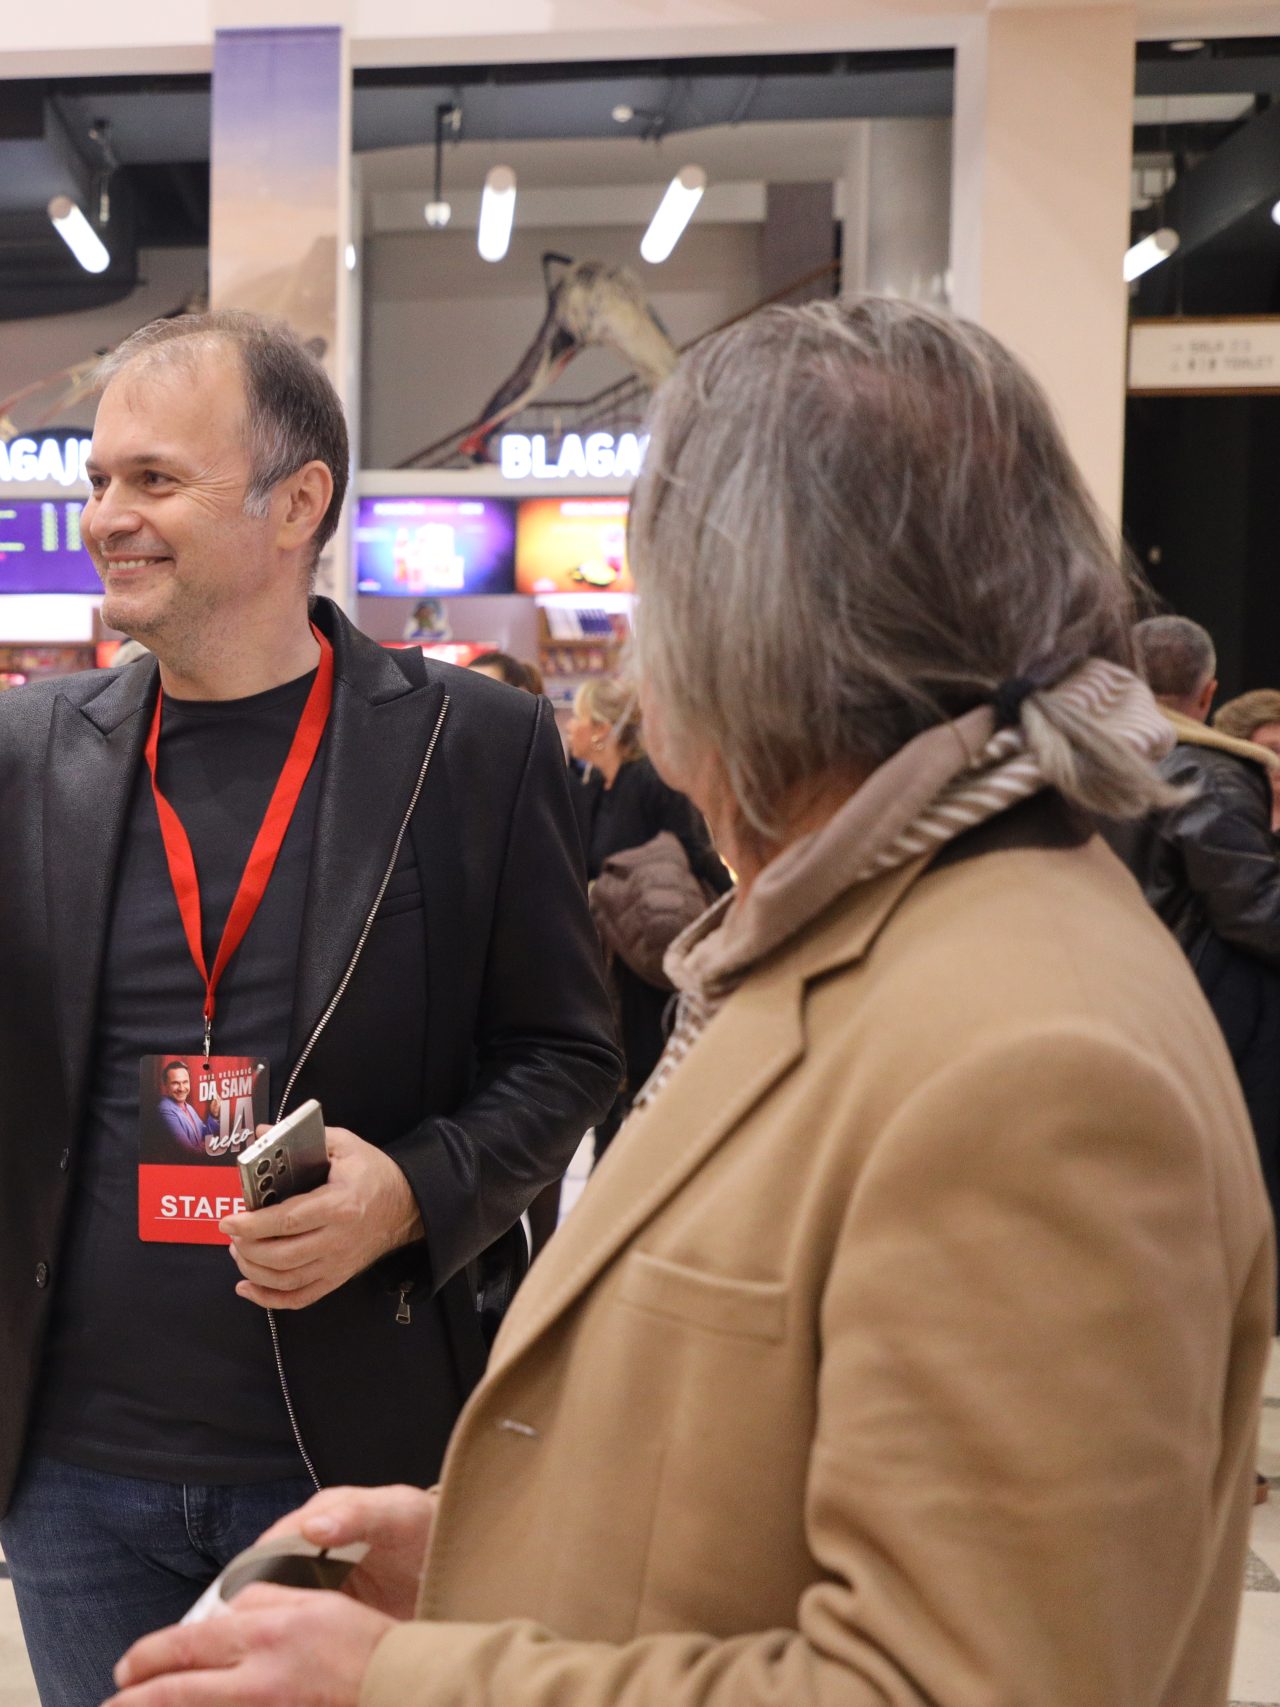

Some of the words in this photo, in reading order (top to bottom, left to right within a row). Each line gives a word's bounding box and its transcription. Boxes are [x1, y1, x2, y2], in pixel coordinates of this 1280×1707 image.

[500, 432, 650, 479] BLAGA
[199, 1081, 218, 1102] DA
[221, 1076, 253, 1100] SAM
[205, 1097, 256, 1157] JA
[209, 1114, 254, 1151] neko
